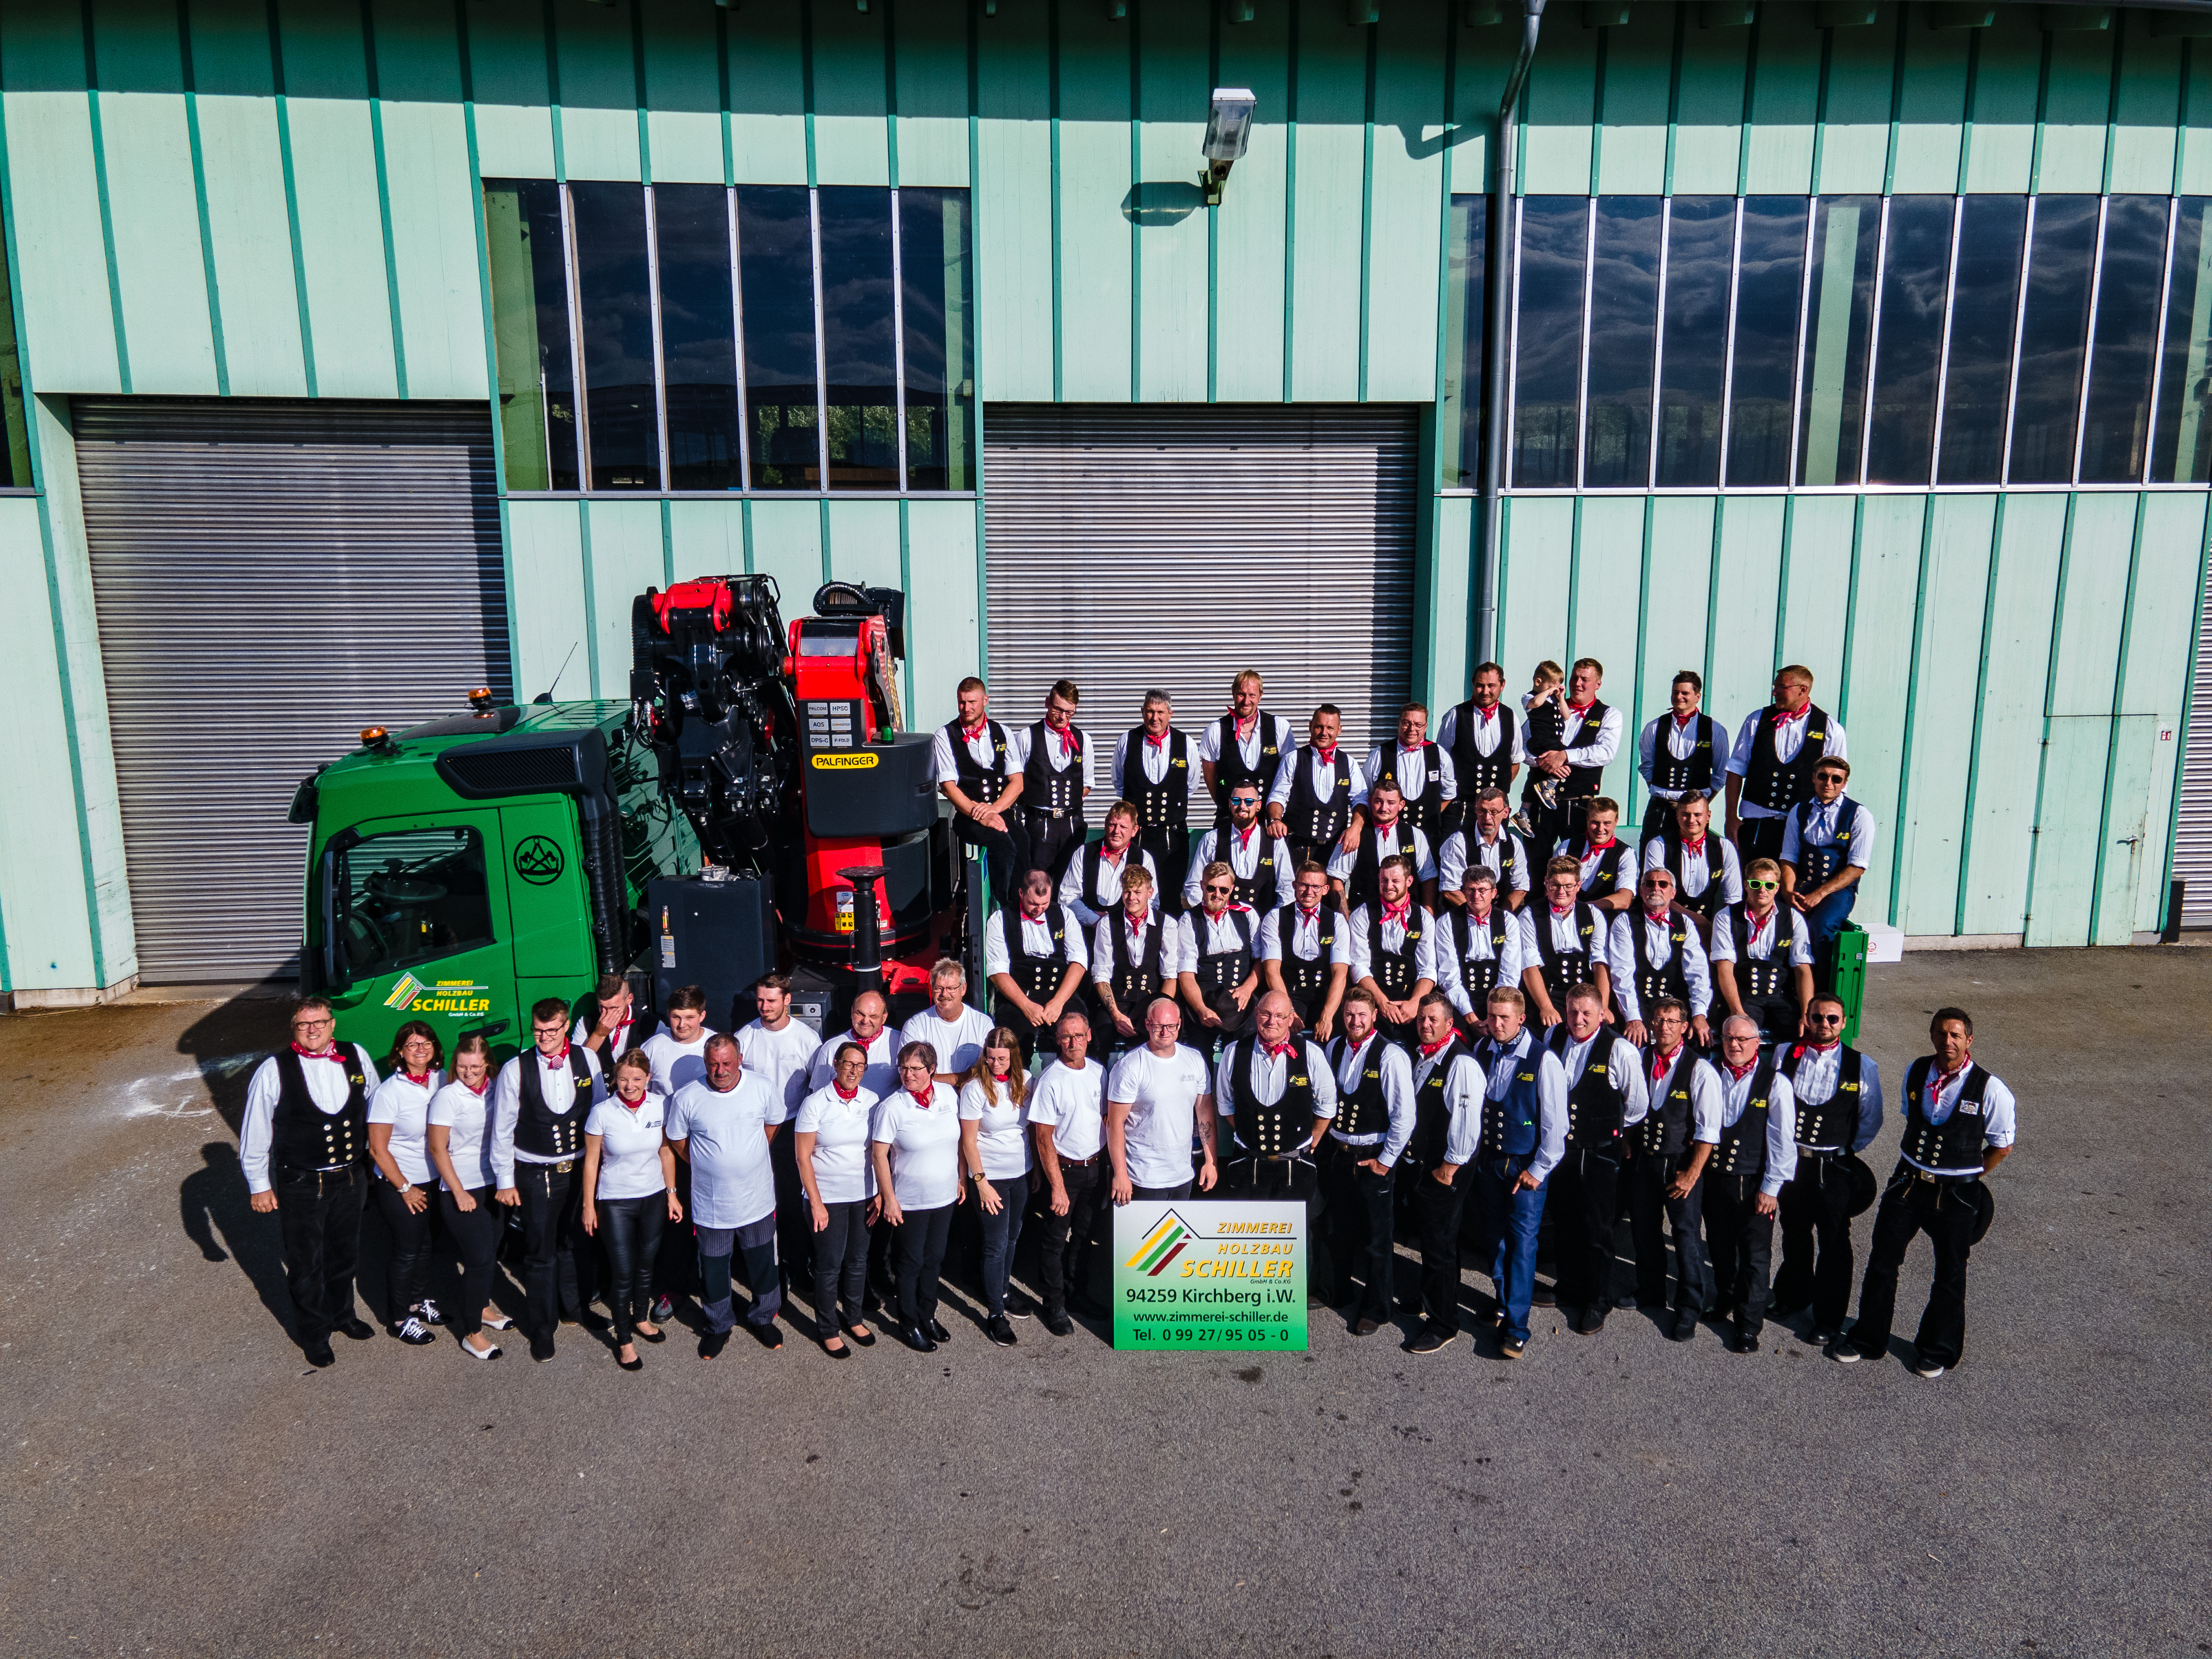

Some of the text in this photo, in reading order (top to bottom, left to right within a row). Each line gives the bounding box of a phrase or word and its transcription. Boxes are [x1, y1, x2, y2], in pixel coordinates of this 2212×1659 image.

[816, 757, 874, 766] PALFINGER
[411, 999, 490, 1011] SCHILLER
[1217, 1222, 1292, 1234] ZIMMEREI
[1217, 1243, 1293, 1255] HOLZBAU
[1180, 1260, 1293, 1278] SCHILLER
[1126, 1288, 1296, 1307] 94259 Kirchberg i.W.
[1133, 1311, 1288, 1322] www.zimmerei-schiller.de
[1133, 1328, 1156, 1341] Tel.
[1162, 1329, 1171, 1341] 0
[1175, 1329, 1193, 1341] 99
[1248, 1329, 1266, 1341] 05
[1280, 1329, 1288, 1341] 0
